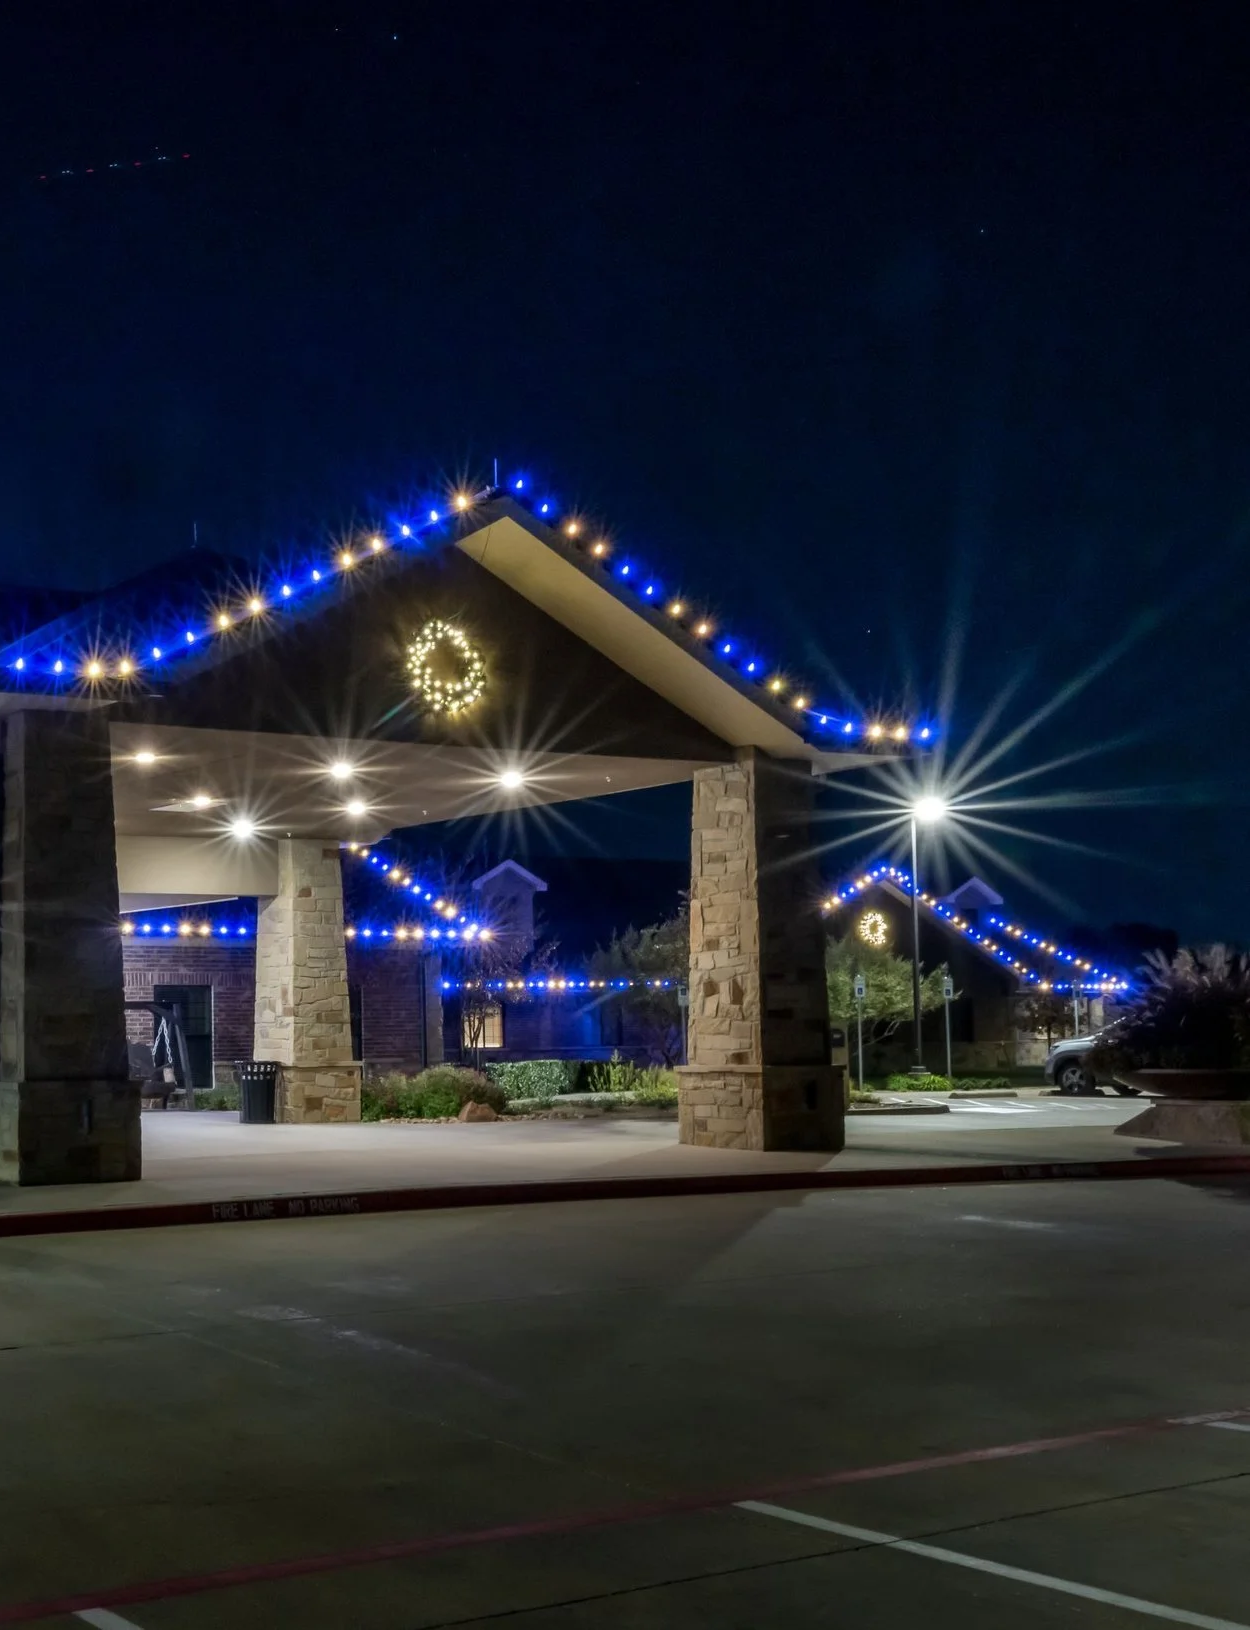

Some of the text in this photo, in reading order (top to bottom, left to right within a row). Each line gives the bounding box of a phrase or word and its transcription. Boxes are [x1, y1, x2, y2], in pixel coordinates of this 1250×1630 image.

[211, 1196, 361, 1220] FIRE LANE NO PARKING
